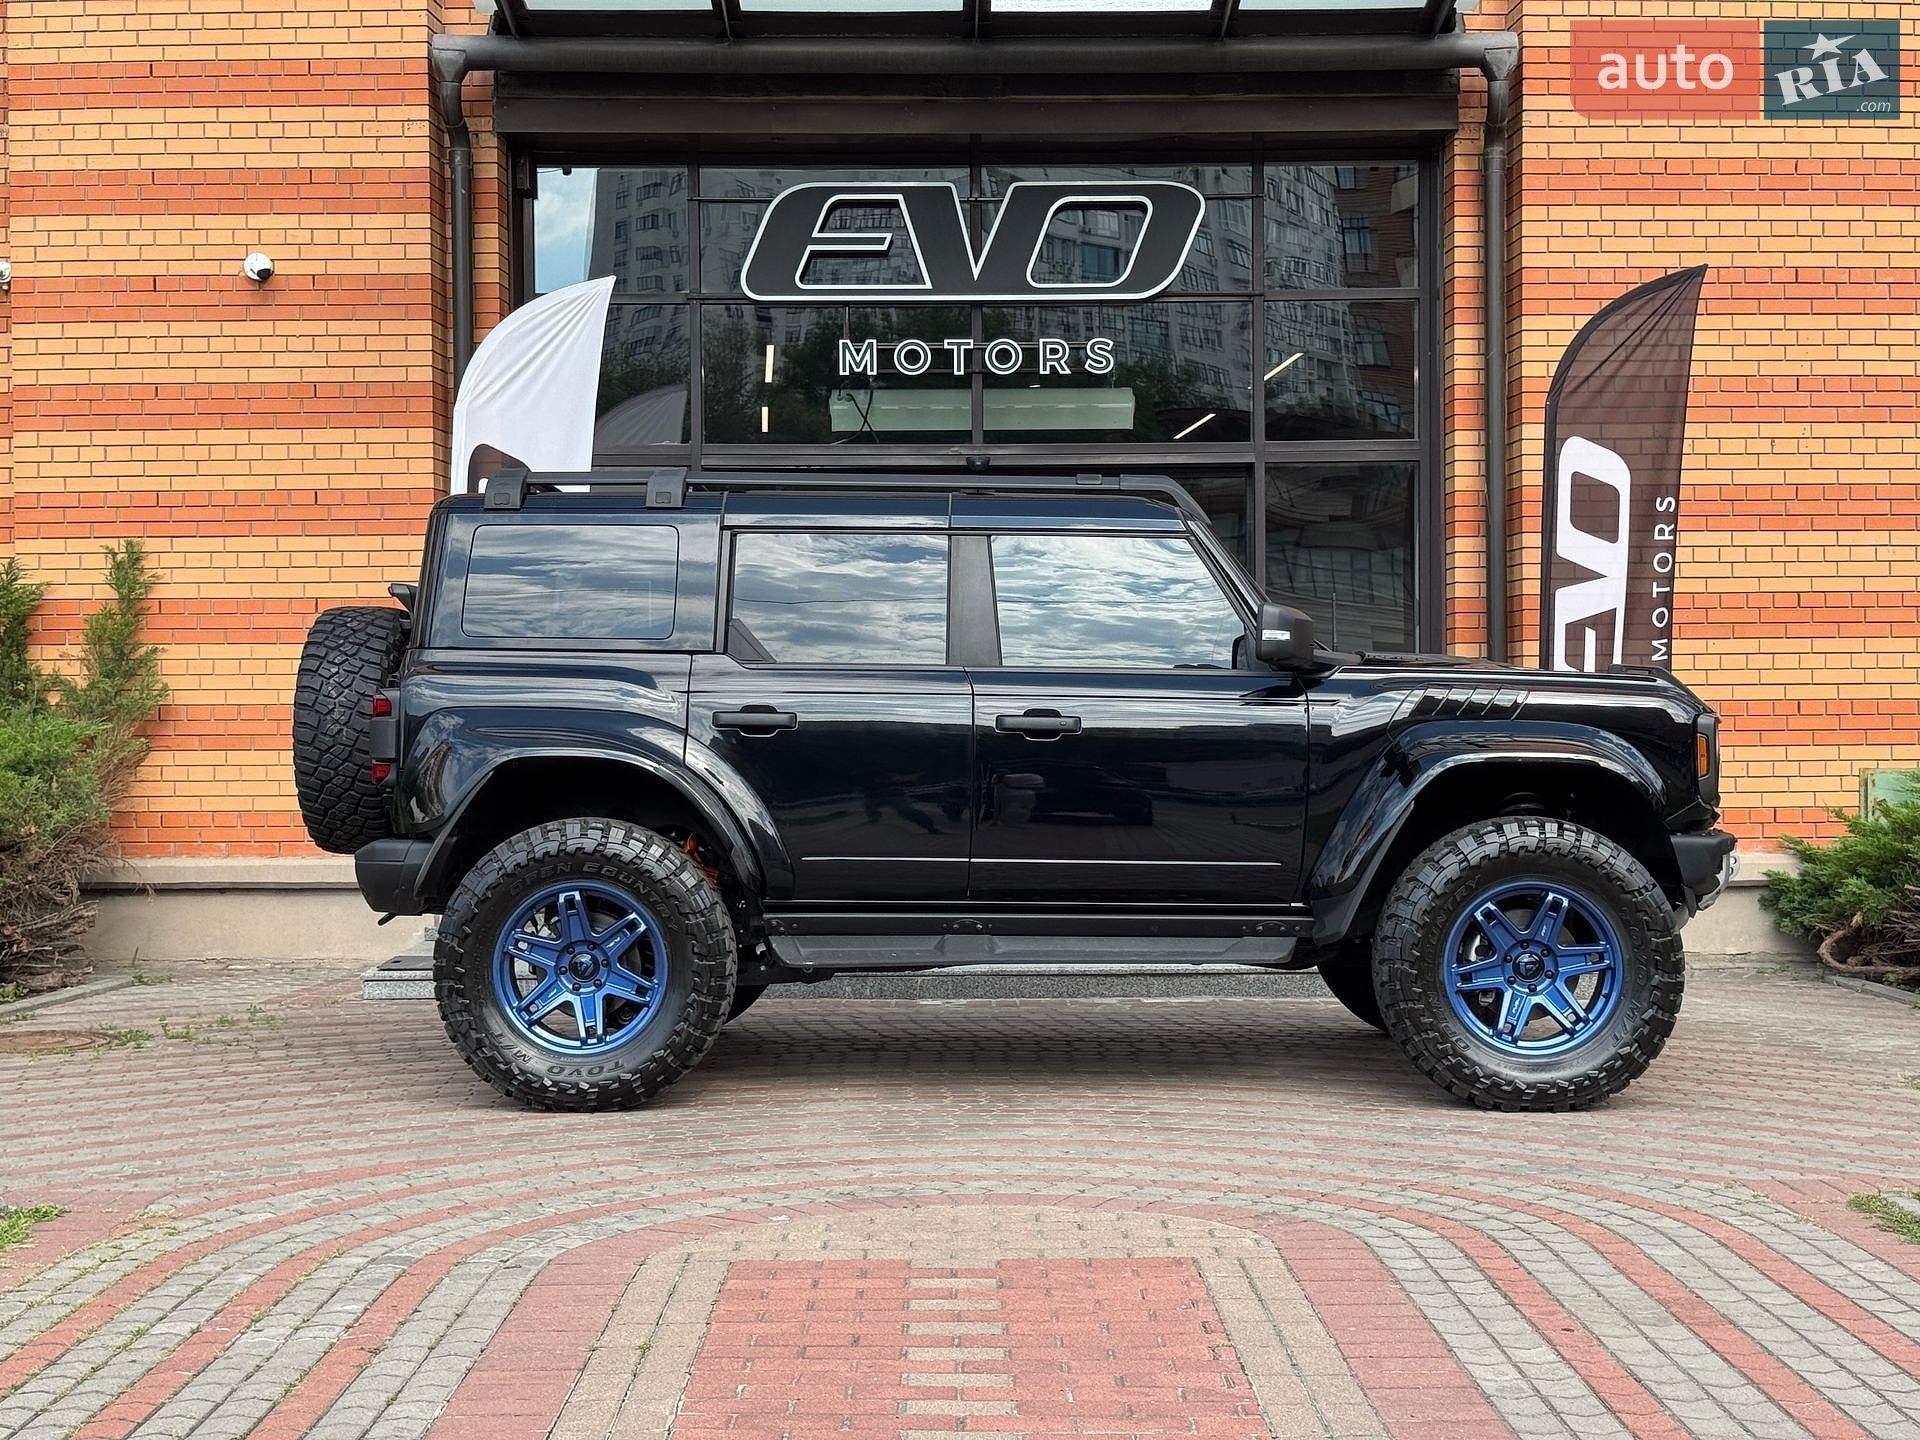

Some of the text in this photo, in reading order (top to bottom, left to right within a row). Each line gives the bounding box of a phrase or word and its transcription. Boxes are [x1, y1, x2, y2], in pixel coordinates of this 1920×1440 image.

[741, 181, 1206, 301] EVO
[838, 338, 1115, 376] MOTORS
[1651, 495, 1677, 661] MOTORS
[544, 1058, 627, 1079] TOYO
